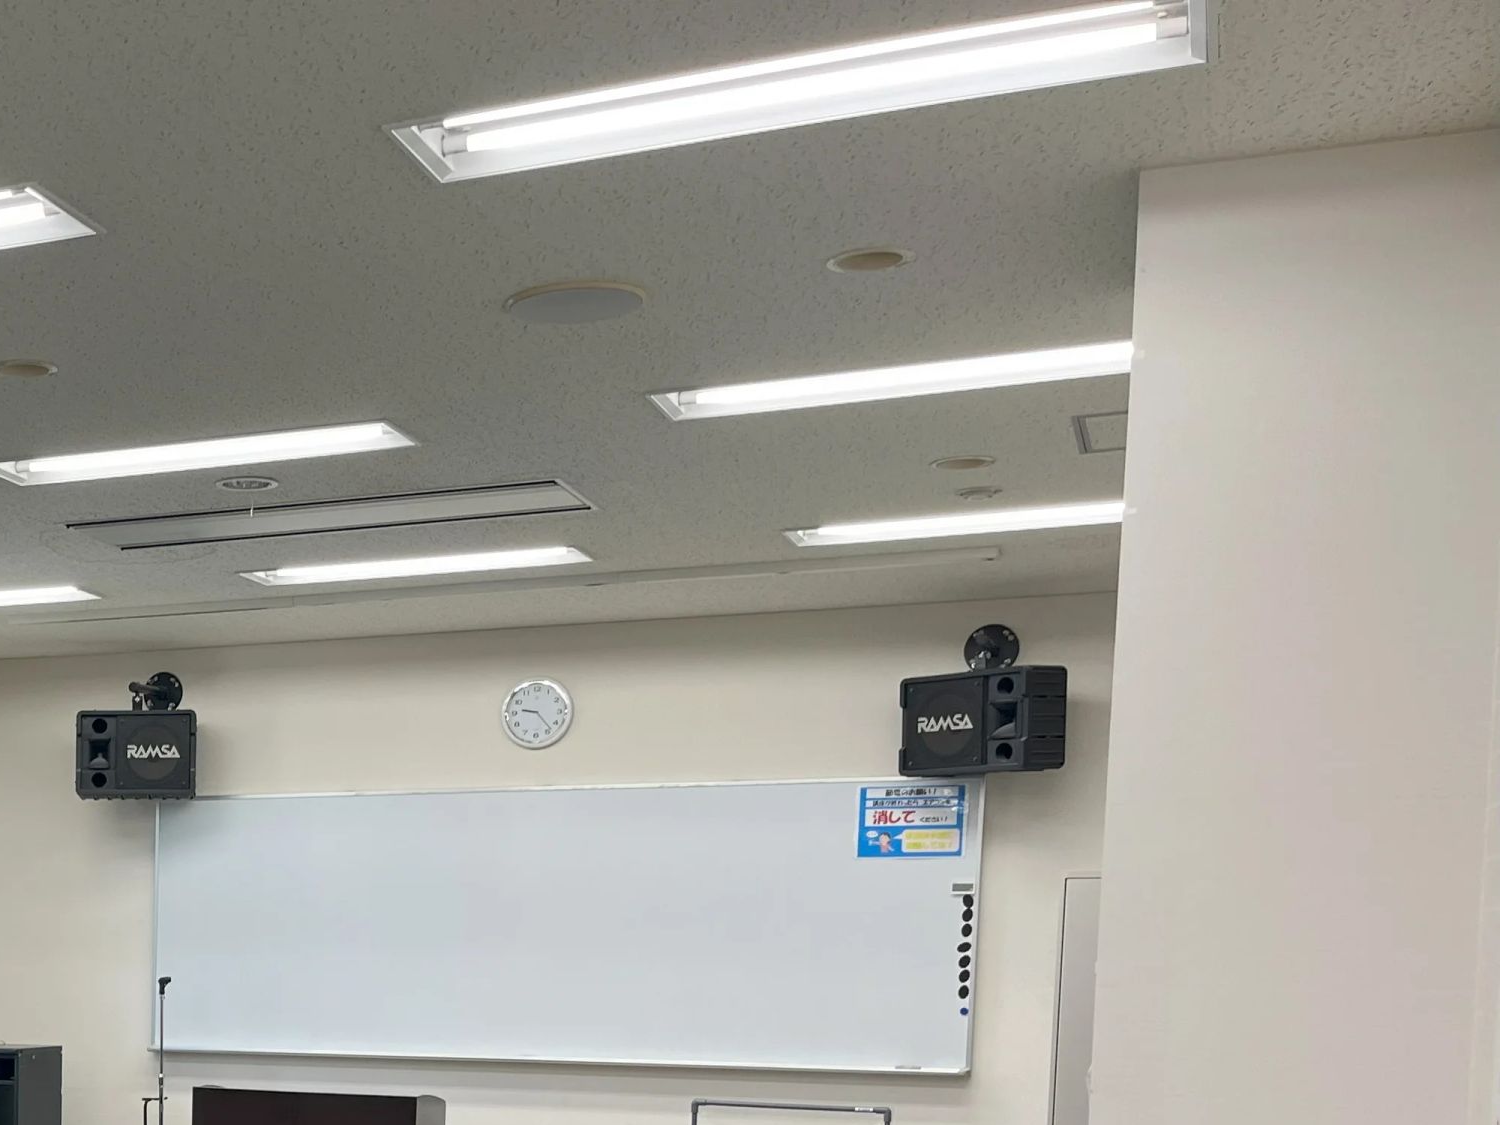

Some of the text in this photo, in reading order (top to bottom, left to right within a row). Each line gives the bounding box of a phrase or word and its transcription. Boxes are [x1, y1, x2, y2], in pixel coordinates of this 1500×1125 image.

[917, 713, 974, 733] RAMSA
[126, 743, 181, 759] RAMSA
[872, 810, 916, 825] 消して
